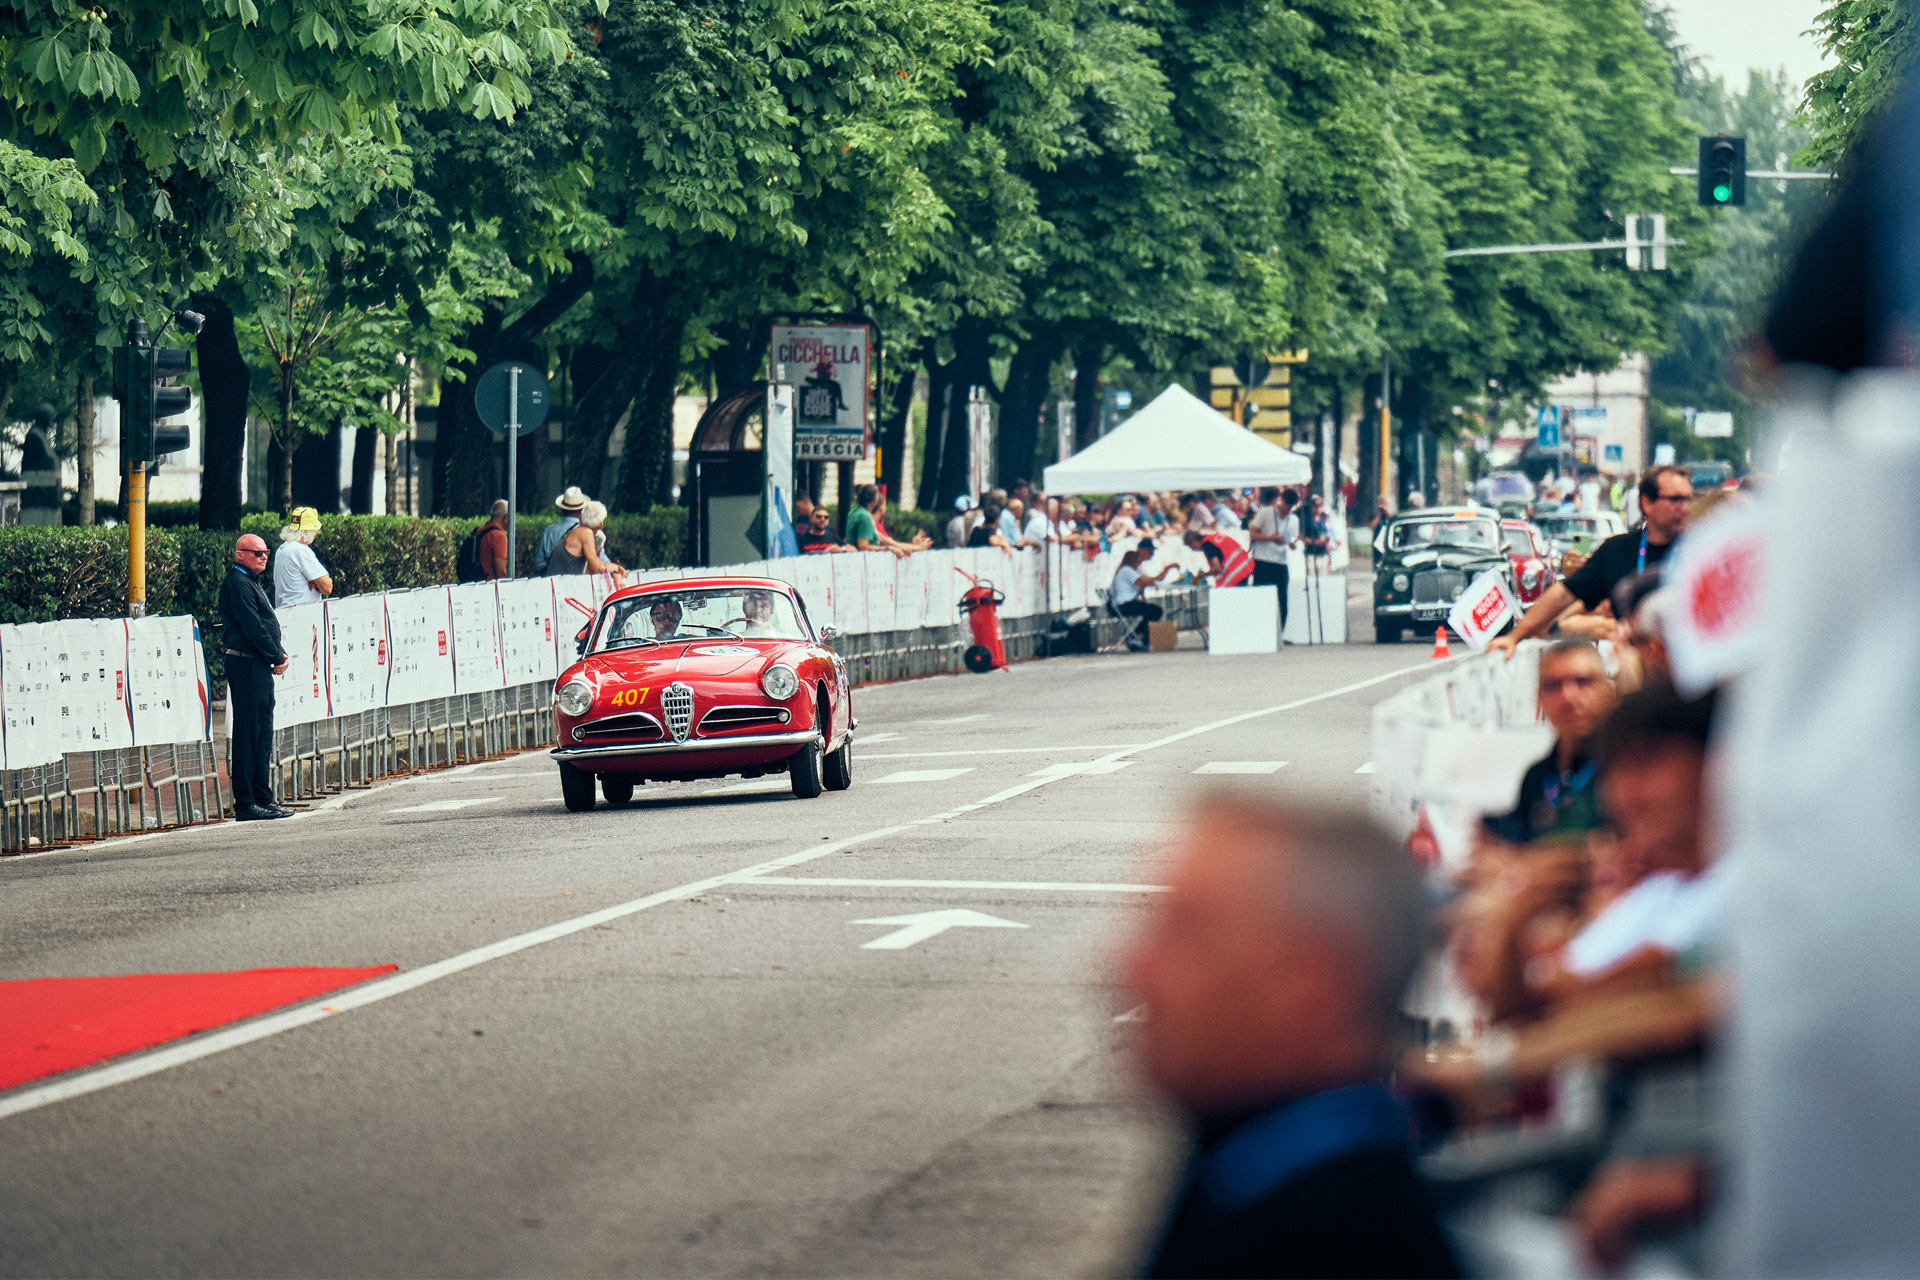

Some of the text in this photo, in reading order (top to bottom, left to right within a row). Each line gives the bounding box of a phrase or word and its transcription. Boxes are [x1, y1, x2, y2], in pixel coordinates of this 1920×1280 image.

[779, 344, 860, 364] CICCHELLA
[796, 435, 824, 443] eatro
[611, 687, 650, 707] 407
